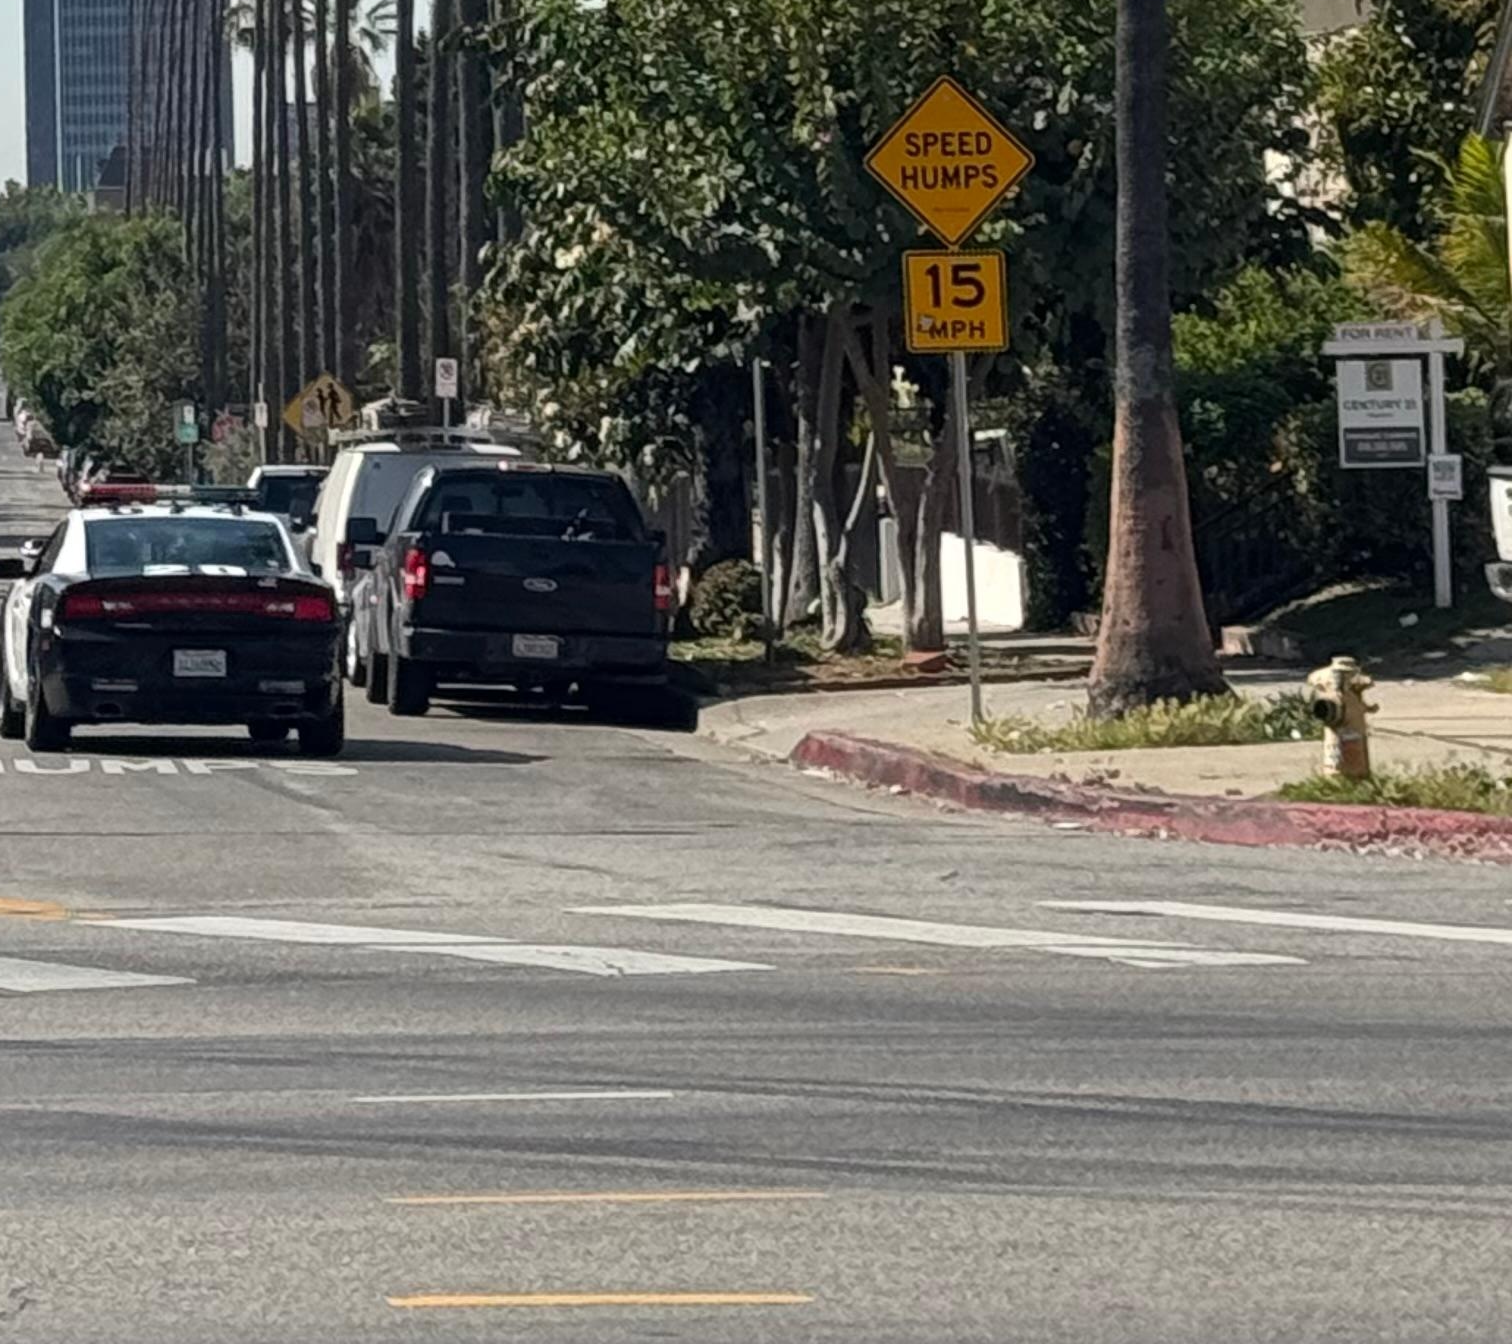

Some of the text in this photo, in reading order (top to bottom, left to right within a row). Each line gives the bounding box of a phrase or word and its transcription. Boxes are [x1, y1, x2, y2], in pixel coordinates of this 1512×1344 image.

[904, 131, 992, 157] SPEED
[900, 164, 999, 190] HUMPS
[925, 263, 985, 308] 15
[929, 319, 986, 339] MPH
[1341, 326, 1413, 340] FOR RENT
[1343, 399, 1402, 411] CENTURY
